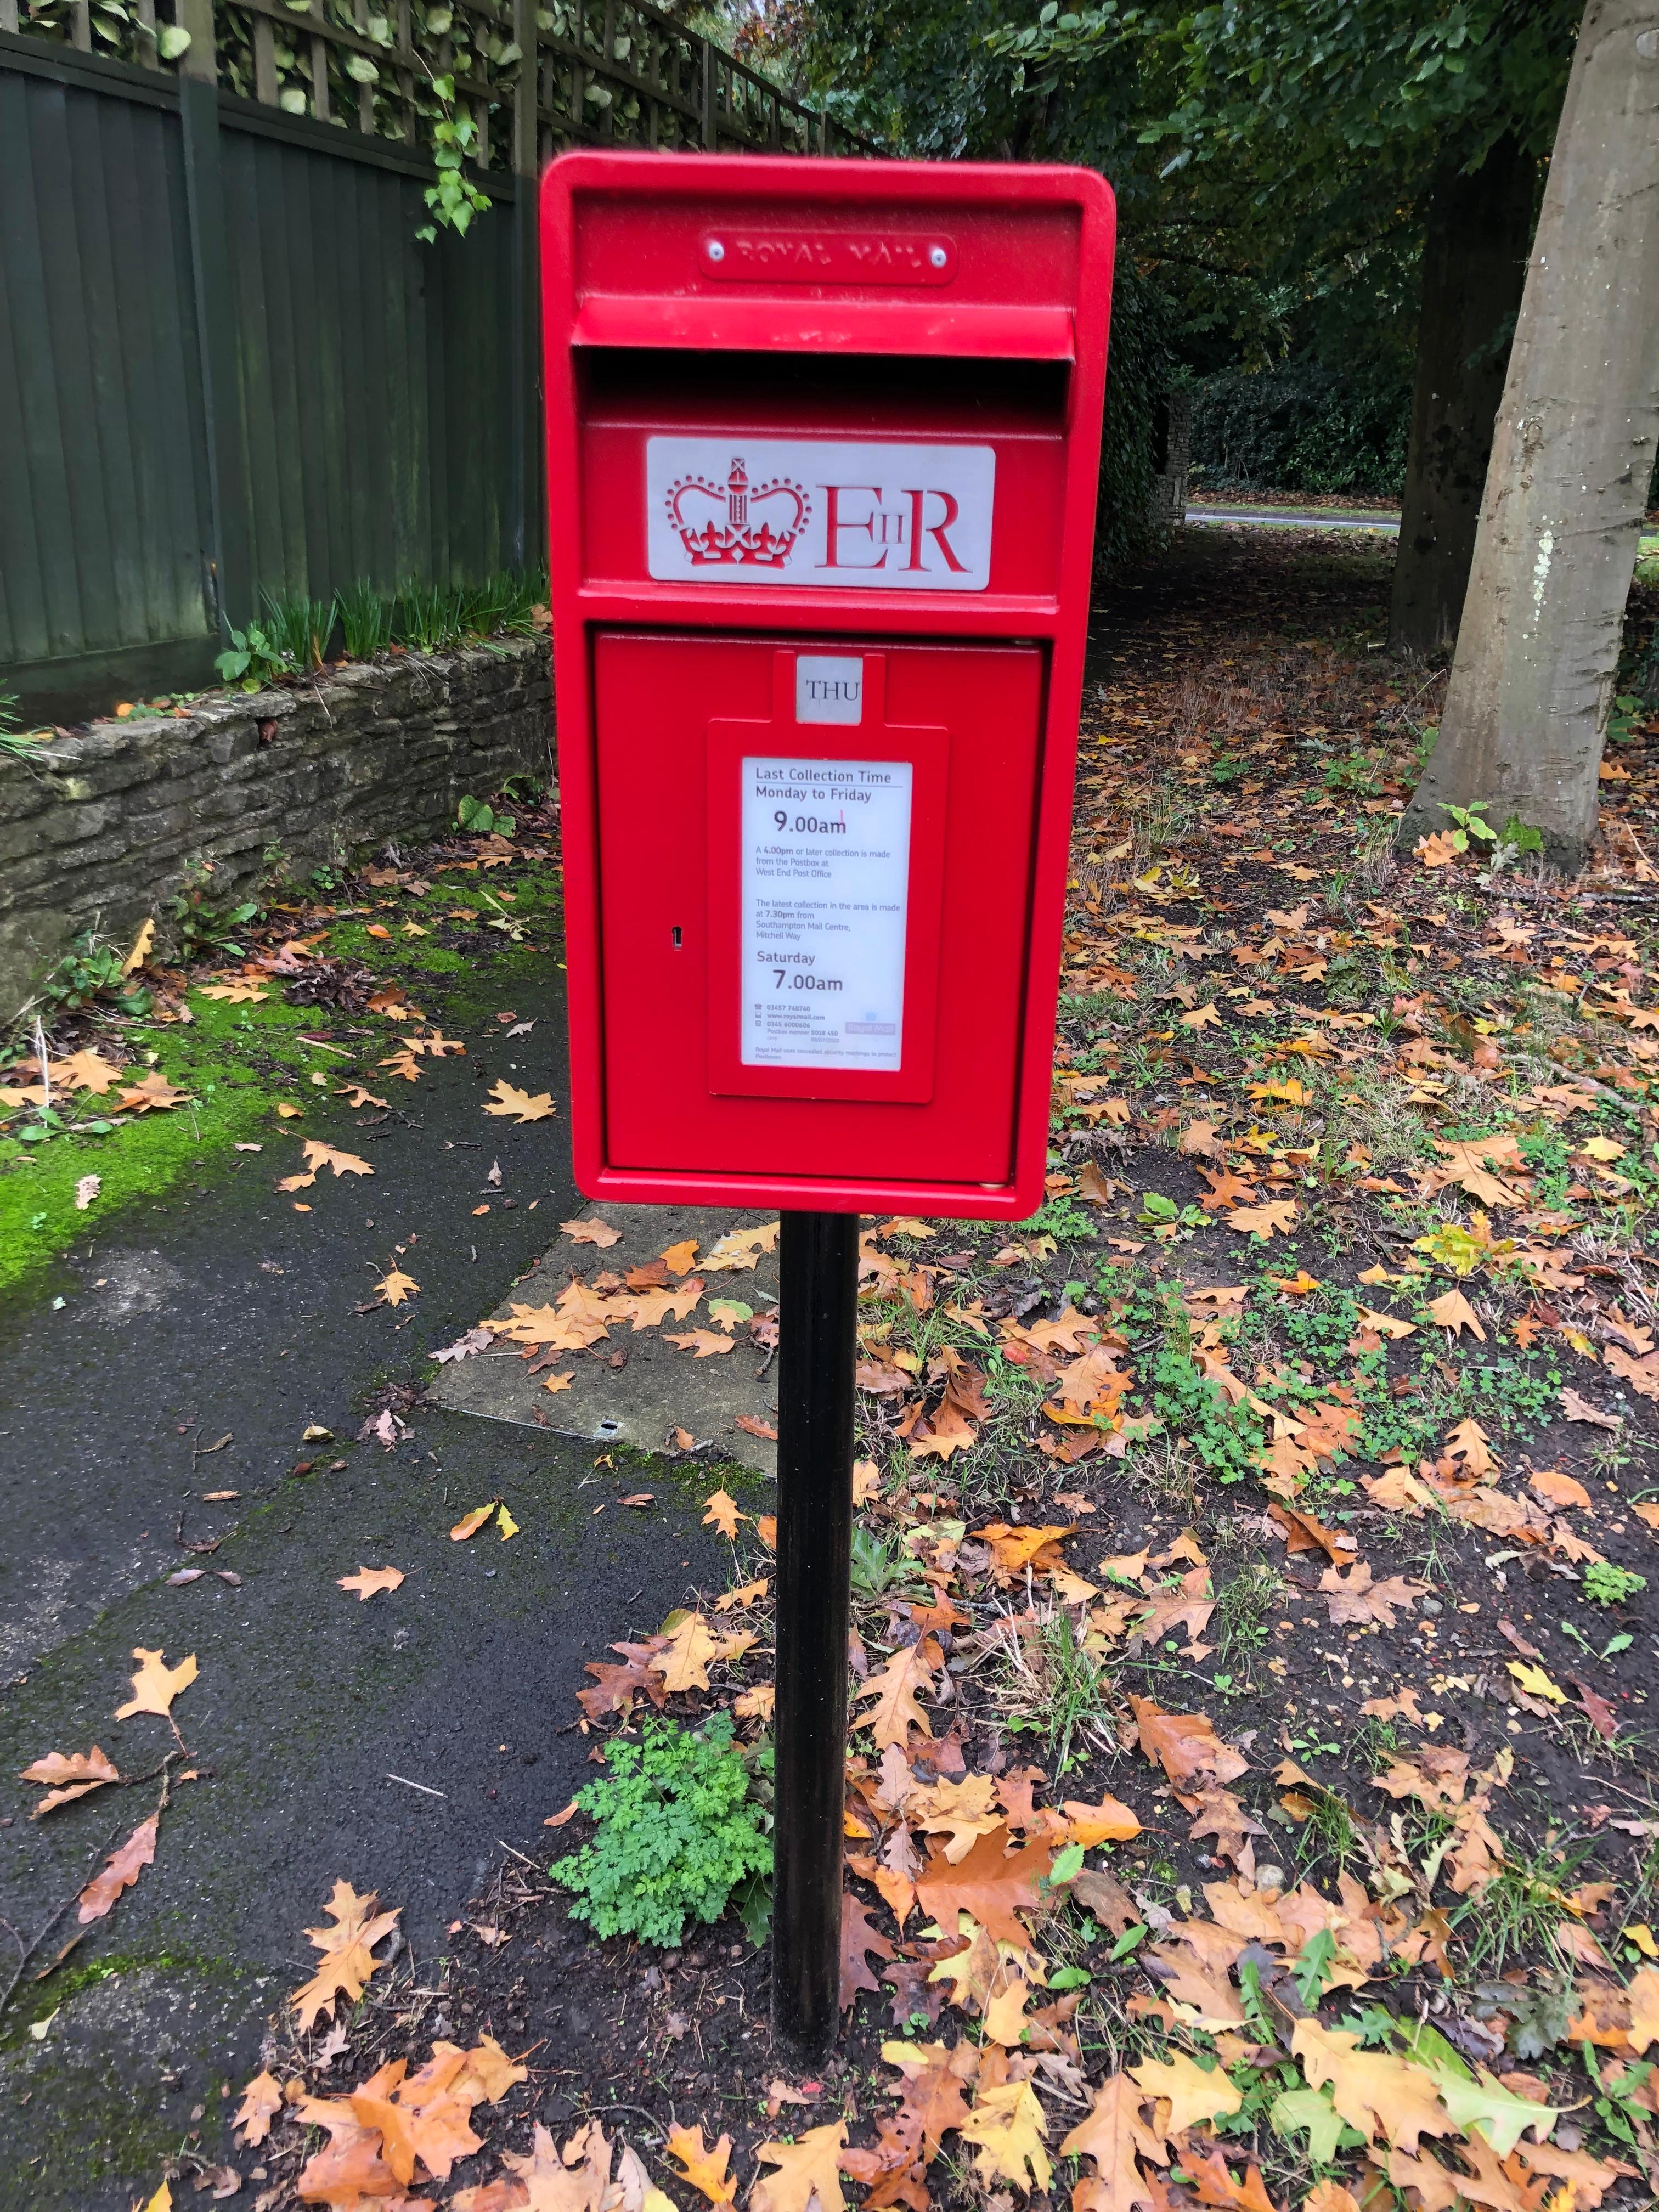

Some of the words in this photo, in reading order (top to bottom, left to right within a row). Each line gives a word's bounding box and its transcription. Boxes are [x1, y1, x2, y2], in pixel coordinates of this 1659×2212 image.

[806, 679, 861, 701] THU
[756, 768, 784, 780] Last
[789, 769, 853, 782] Collection
[858, 770, 891, 783] Time
[756, 786, 807, 802] Monday
[812, 788, 825, 800] to
[831, 788, 872, 804] Friday
[774, 810, 847, 834] 9.00am
[763, 847, 793, 856] 4.00pm
[806, 848, 822, 856] later
[825, 849, 859, 857] collection
[869, 850, 890, 859] made
[756, 857, 774, 865] from
[790, 859, 820, 867] Postbox
[756, 868, 775, 876] West
[777, 868, 791, 877] End
[793, 869, 809, 877] Post
[811, 869, 832, 878] Office
[772, 900, 792, 908] latest
[794, 901, 828, 909] collection
[839, 902, 851, 910] the
[879, 904, 900, 912] made
[765, 911, 795, 920] 7.30pm
[756, 921, 805, 930] Southampton
[808, 922, 823, 930] Mail
[825, 923, 851, 932] Centre,
[785, 932, 801, 941] Way
[757, 950, 816, 966] Saturday
[773, 970, 843, 991] 7.00am
